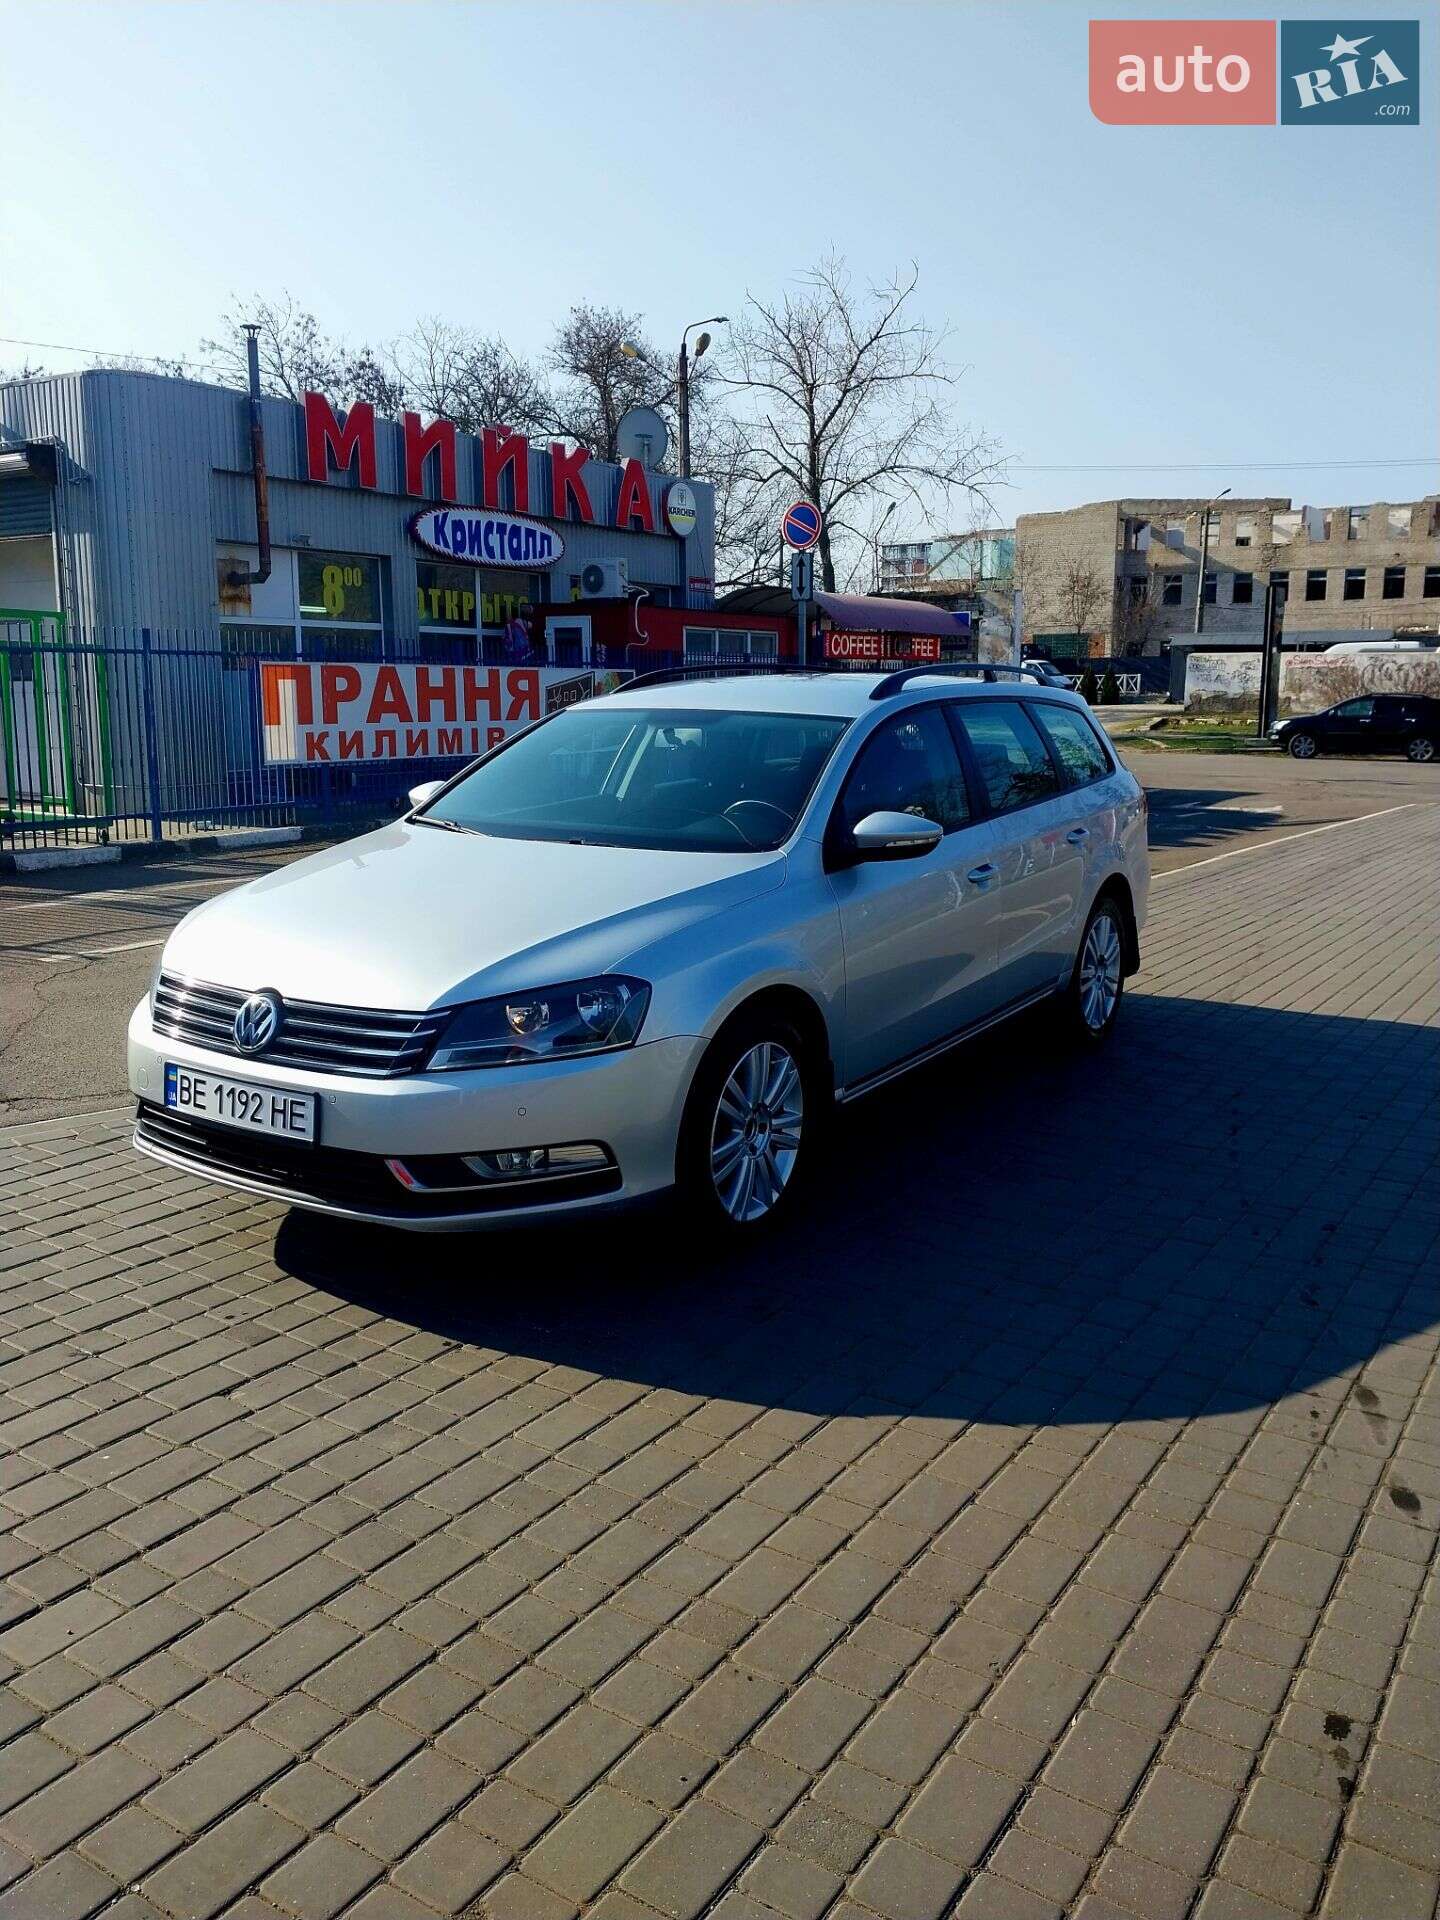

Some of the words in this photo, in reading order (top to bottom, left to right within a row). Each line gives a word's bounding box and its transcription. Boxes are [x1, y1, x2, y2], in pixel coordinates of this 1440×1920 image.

[299, 390, 654, 533] МИЙКА
[433, 511, 553, 561] Кристалл
[832, 635, 879, 656] COFFEE
[262, 663, 540, 726] ПРАННЯ
[179, 1075, 207, 1110] BE
[214, 1084, 264, 1124] 1192
[270, 1095, 306, 1132] HE
